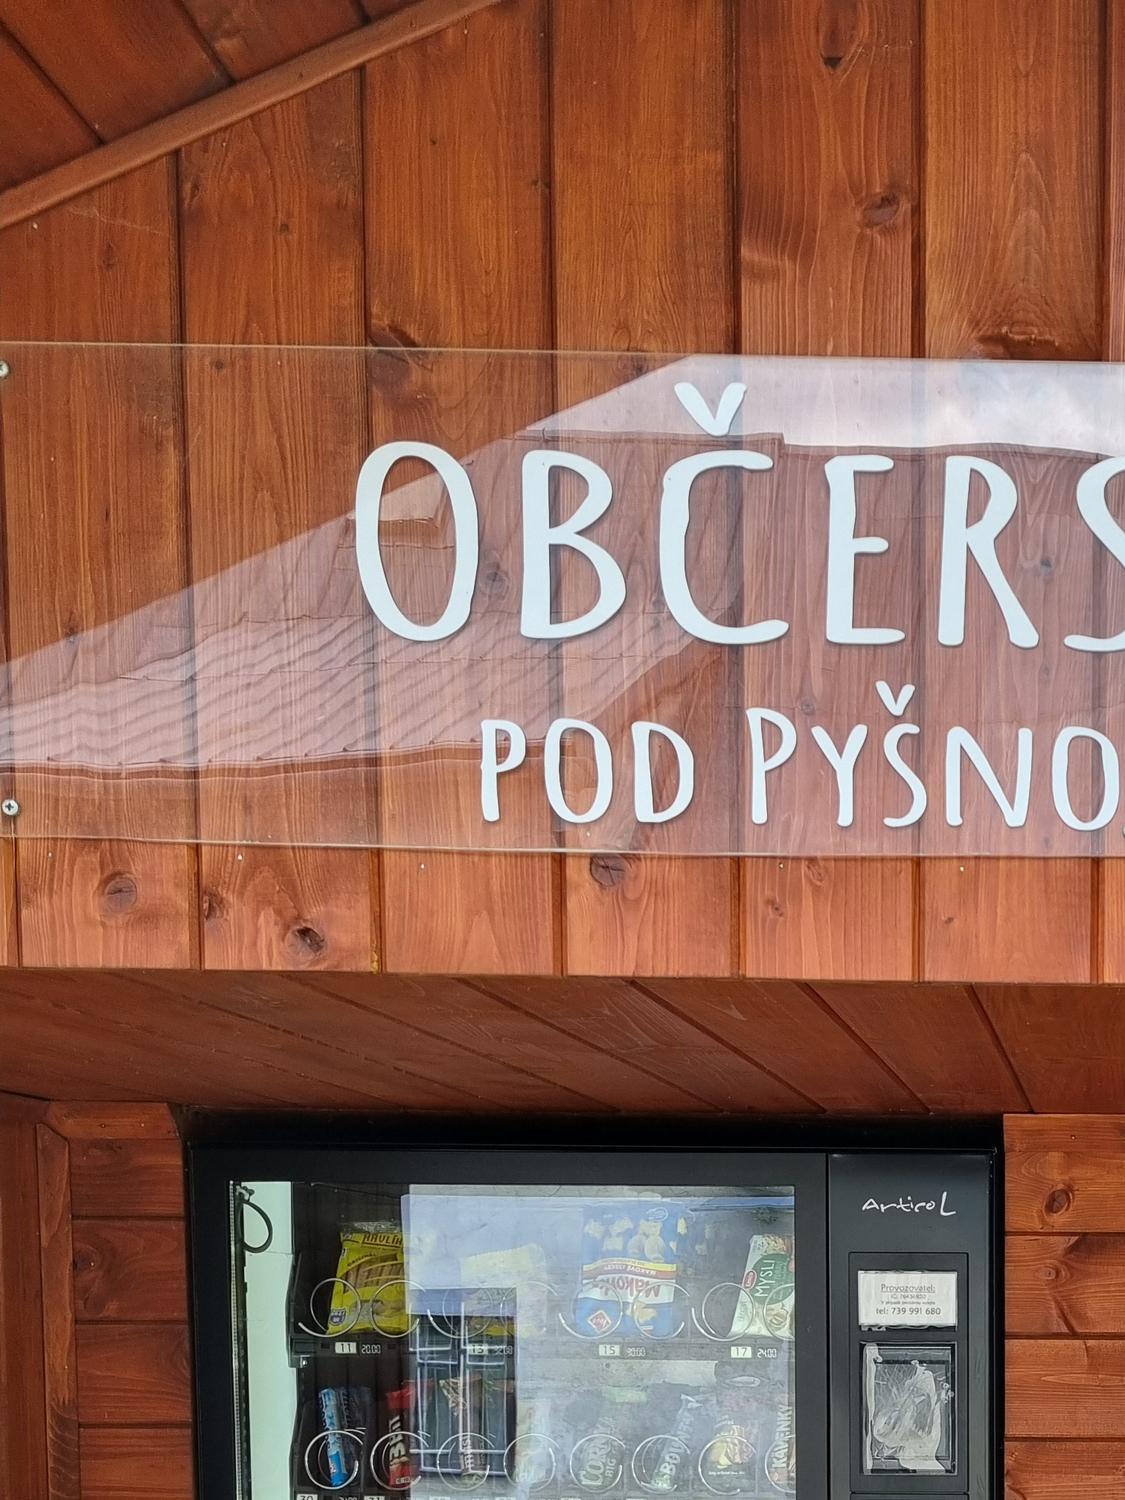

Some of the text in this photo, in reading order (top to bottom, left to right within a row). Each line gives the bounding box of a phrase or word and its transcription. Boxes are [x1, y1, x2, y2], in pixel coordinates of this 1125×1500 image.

[480, 716, 694, 824] POD
[754, 1258, 776, 1297] MYSLI
[881, 1284, 935, 1294] Provozovatel:
[925, 1307, 941, 1315] 680
[341, 1344, 350, 1353] 11
[604, 1346, 615, 1355] 15
[736, 1348, 747, 1356] 17
